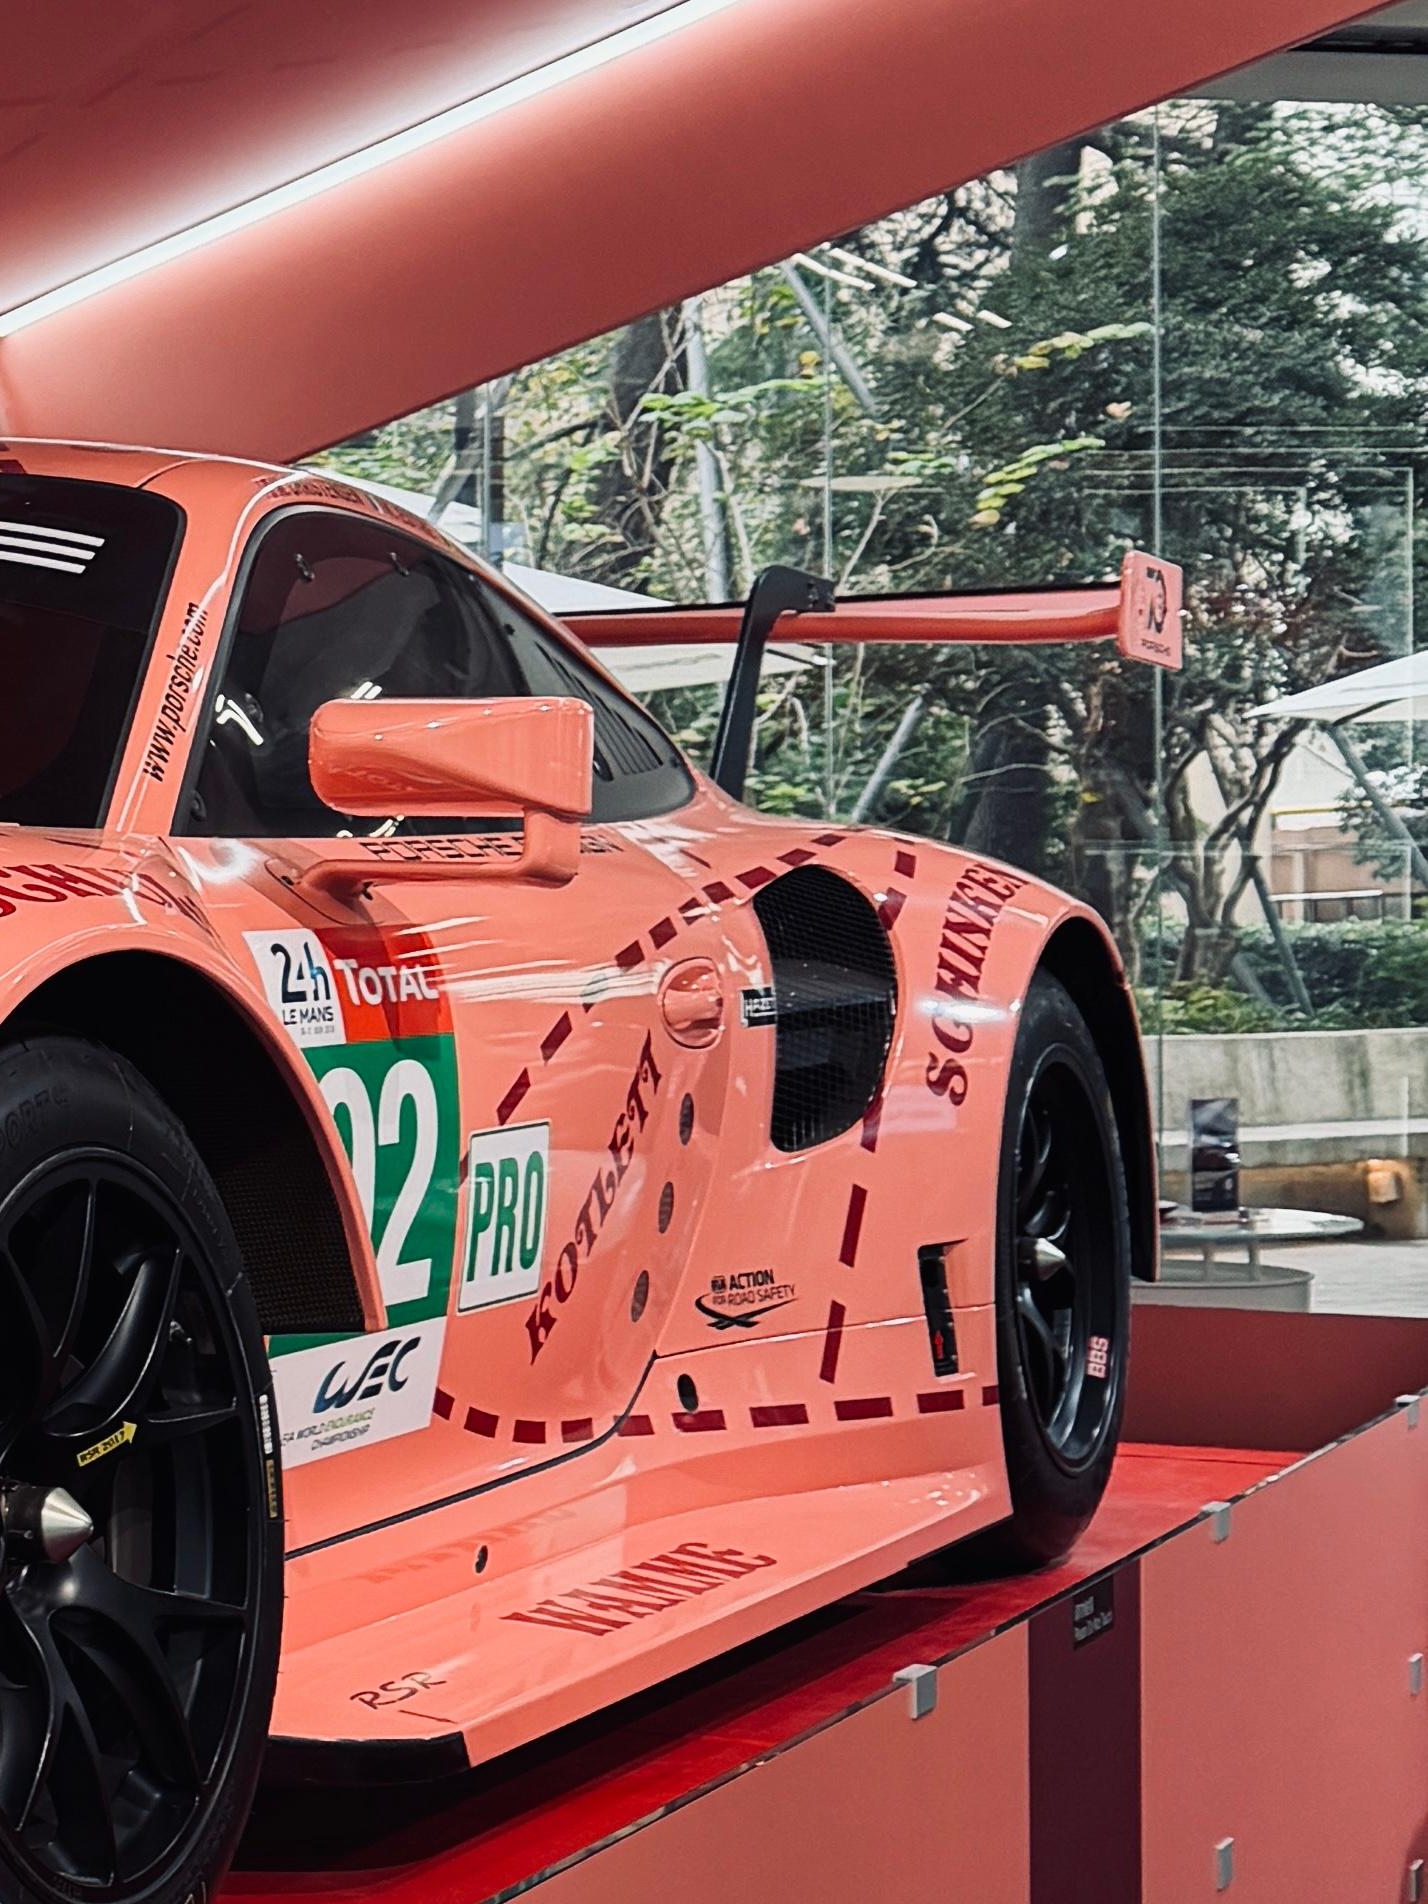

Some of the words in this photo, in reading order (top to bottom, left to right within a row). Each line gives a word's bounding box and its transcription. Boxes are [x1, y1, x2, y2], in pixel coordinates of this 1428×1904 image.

[270, 942, 331, 1004] 24h
[334, 958, 441, 1006] TOTAL
[466, 1150, 544, 1283] PRO
[525, 1031, 664, 1365] KOTLETT
[729, 1268, 775, 1291] ACTION
[757, 1284, 796, 1302] SAFETY
[312, 1336, 422, 1415] WEC
[501, 1541, 778, 1638] WAMME
[350, 1669, 447, 1714] RSR
